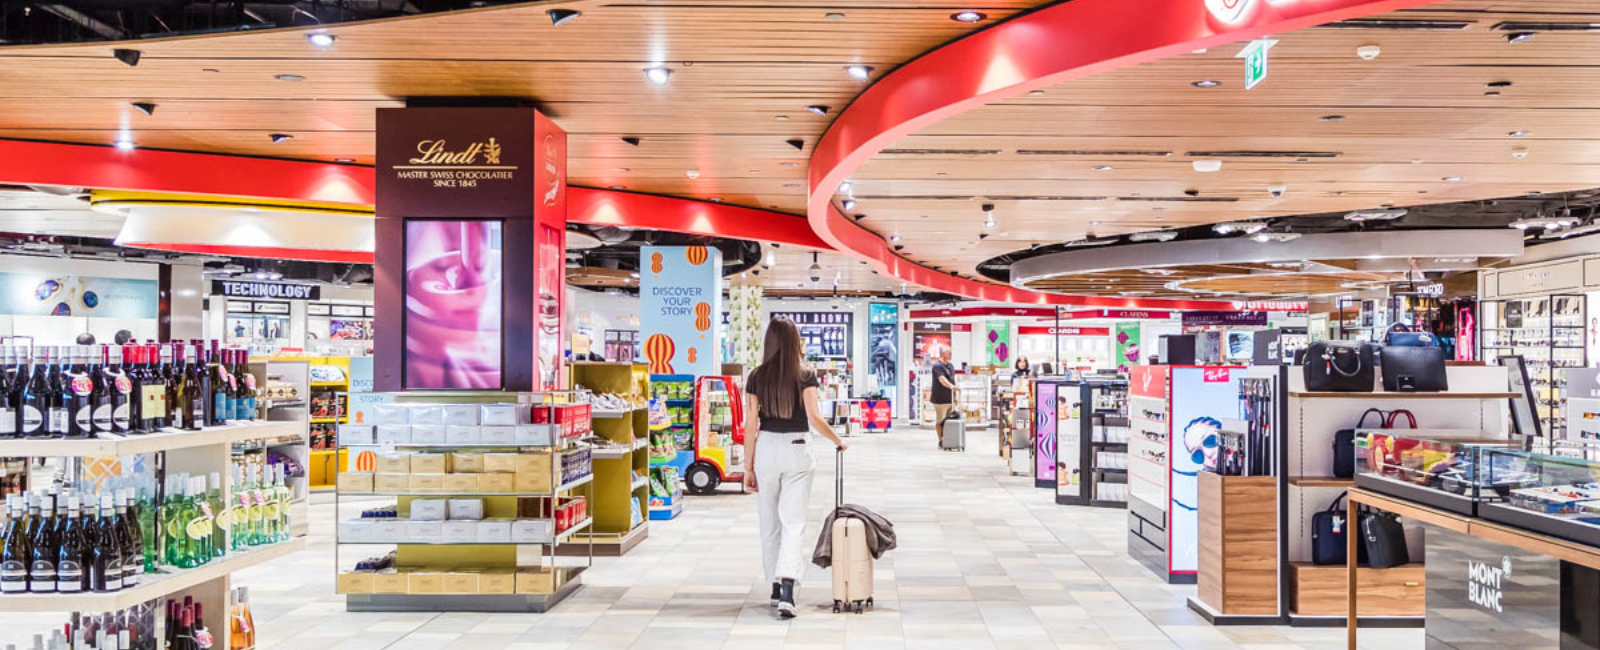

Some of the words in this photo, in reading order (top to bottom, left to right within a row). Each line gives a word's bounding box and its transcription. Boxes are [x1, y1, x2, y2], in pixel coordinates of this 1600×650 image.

[409, 139, 483, 164] Lindt
[397, 171, 428, 179] MASTER
[430, 171, 454, 179] SWISS
[455, 171, 513, 179] CHOCOLATIER
[458, 179, 477, 187] 1845
[222, 282, 311, 298] TECHNOLOGY
[652, 287, 702, 296] DISCOVER
[663, 297, 691, 306] YOUR
[661, 307, 692, 316] STORY
[814, 314, 849, 323] BROWN
[1468, 559, 1502, 590] MONT
[1468, 580, 1503, 613] BLANC
